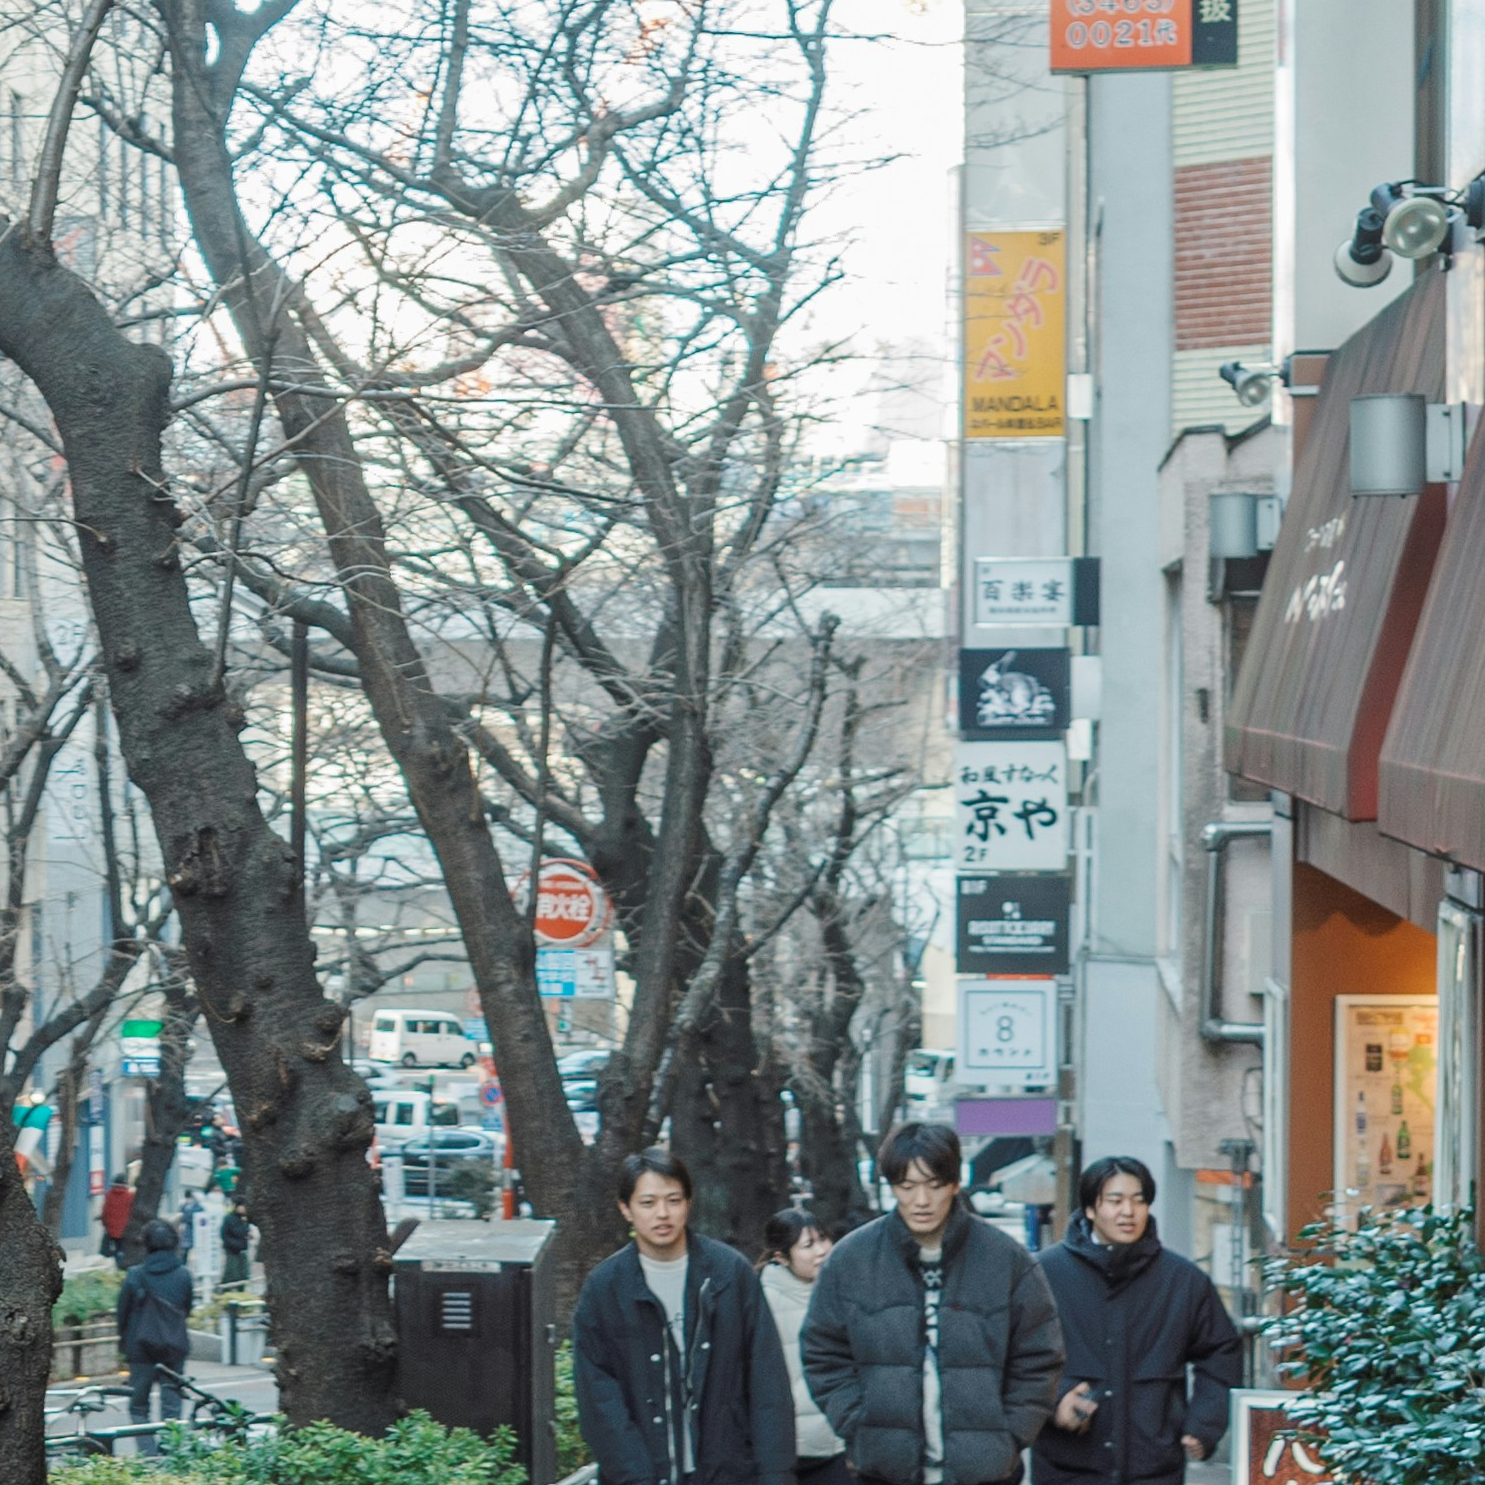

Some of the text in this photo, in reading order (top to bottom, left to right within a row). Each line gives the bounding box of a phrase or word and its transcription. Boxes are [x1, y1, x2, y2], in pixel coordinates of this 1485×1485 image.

[971, 395, 1060, 412] MANDALA
[960, 788, 1058, 843] 京や
[963, 845, 988, 863] 2F
[996, 1015, 1014, 1043] 8
